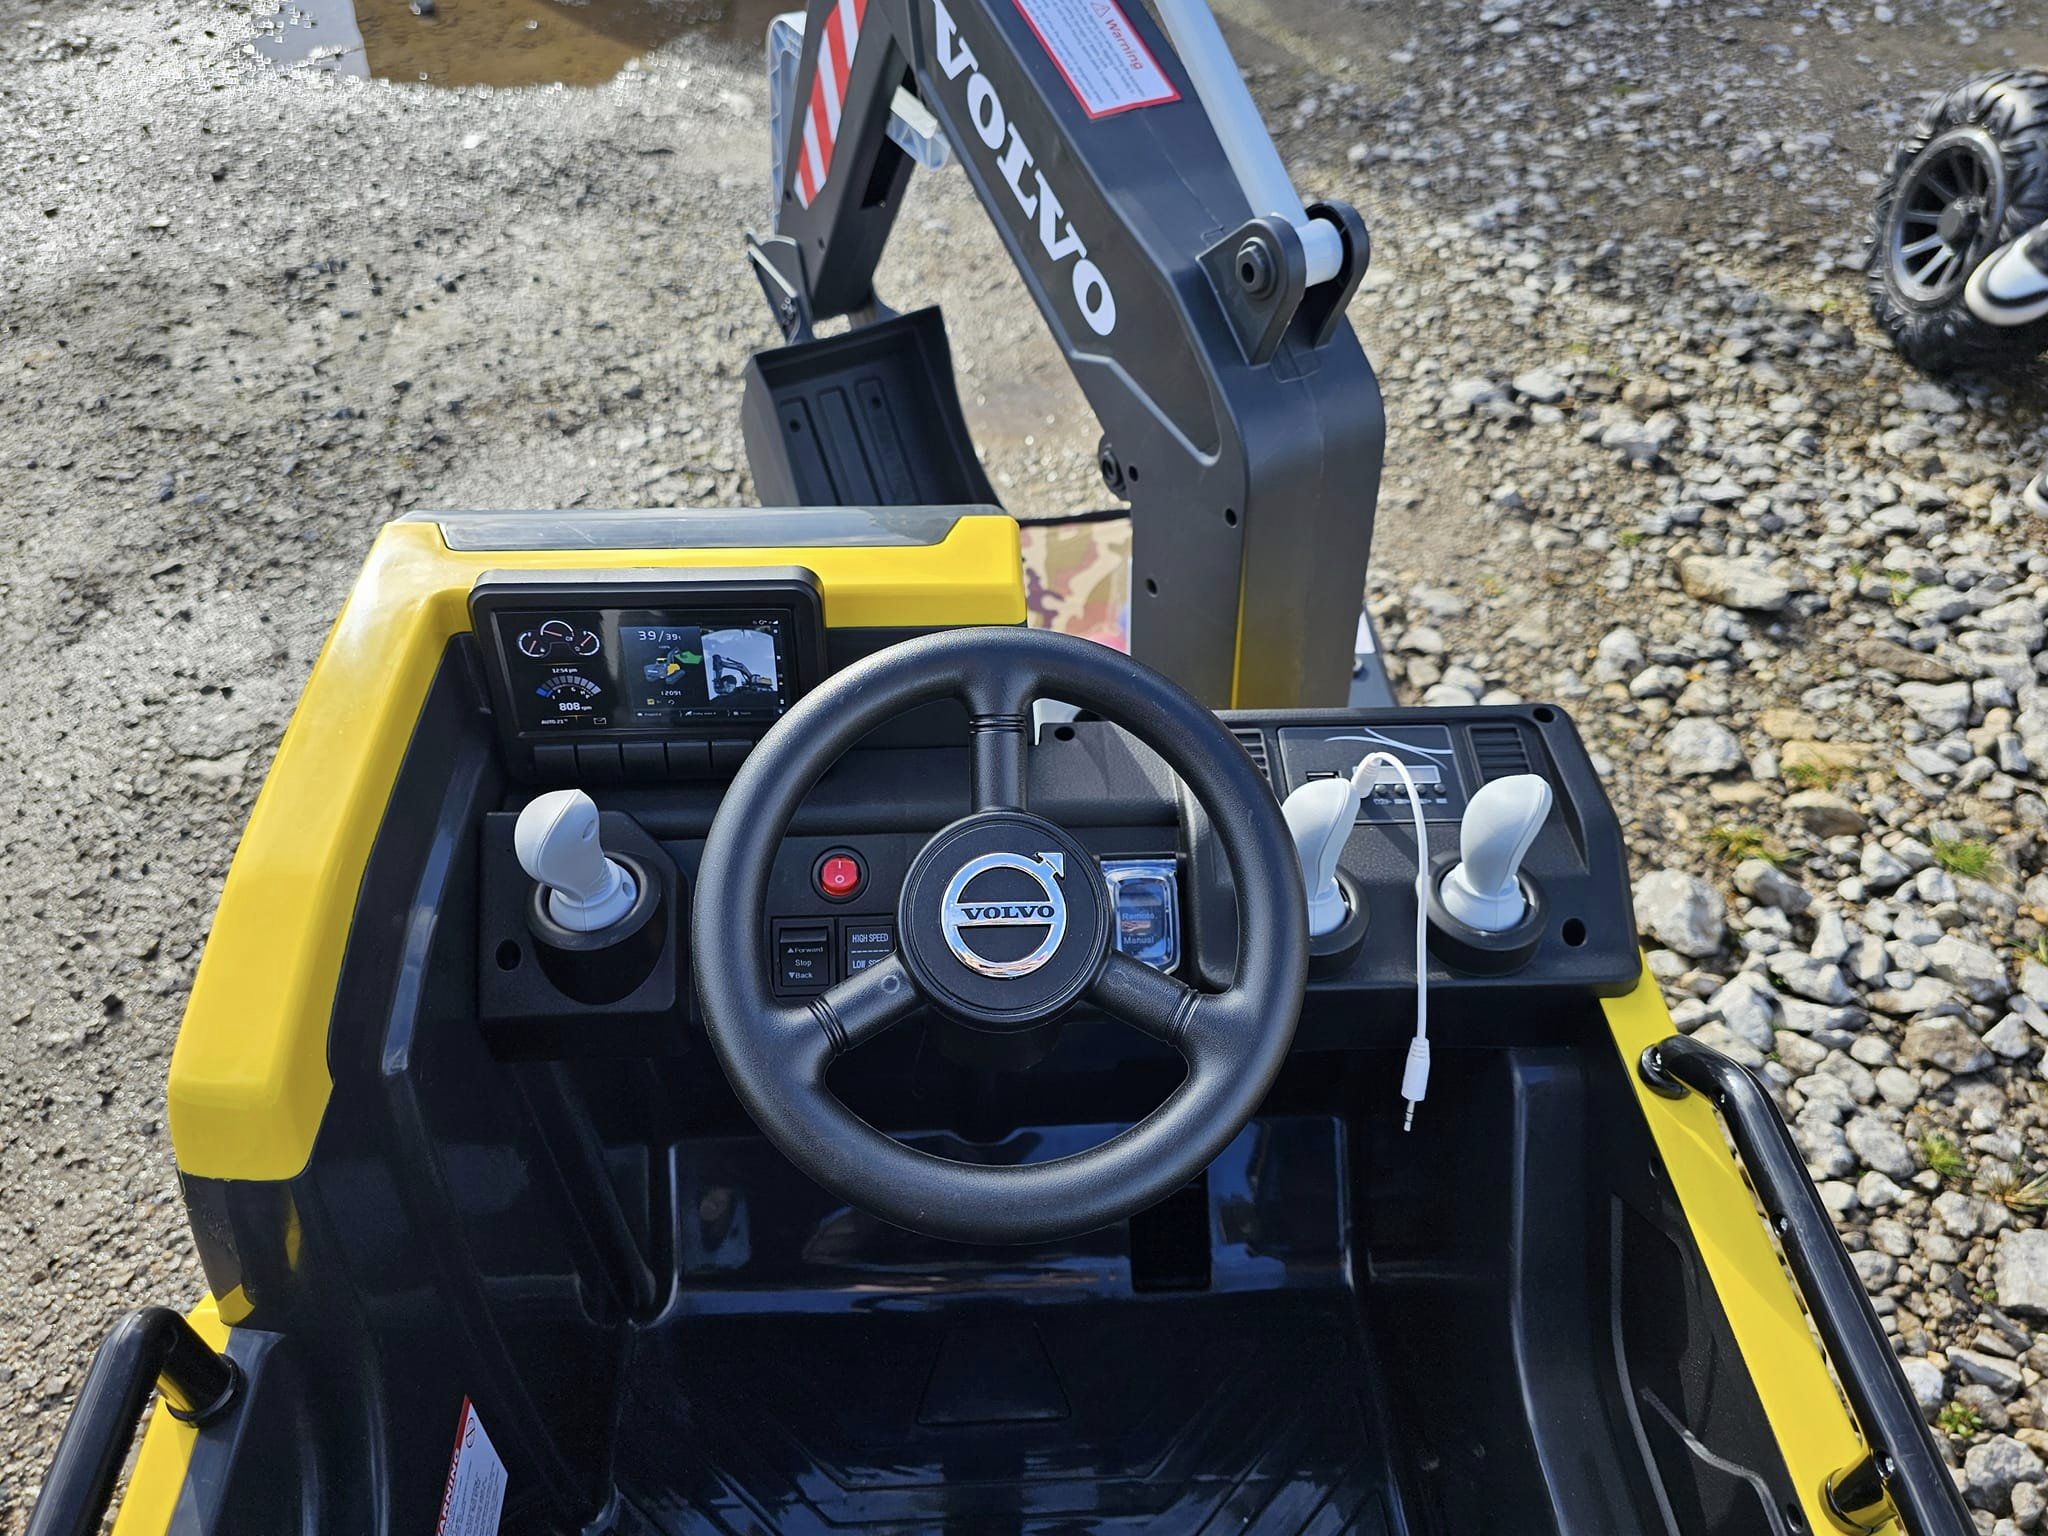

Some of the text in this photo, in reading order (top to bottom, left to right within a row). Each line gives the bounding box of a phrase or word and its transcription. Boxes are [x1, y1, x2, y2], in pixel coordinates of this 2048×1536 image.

[1105, 18, 1143, 71] Warning
[934, 0, 1117, 336] VOLVO
[559, 702, 580, 711] 808
[961, 905, 1055, 920] VOLVO
[852, 933, 889, 943] HIGH SPEED
[1123, 936, 1155, 945] Manual
[795, 959, 812, 967] Stop
[852, 960, 866, 969] LOW
[437, 1447, 460, 1536] ARNING
